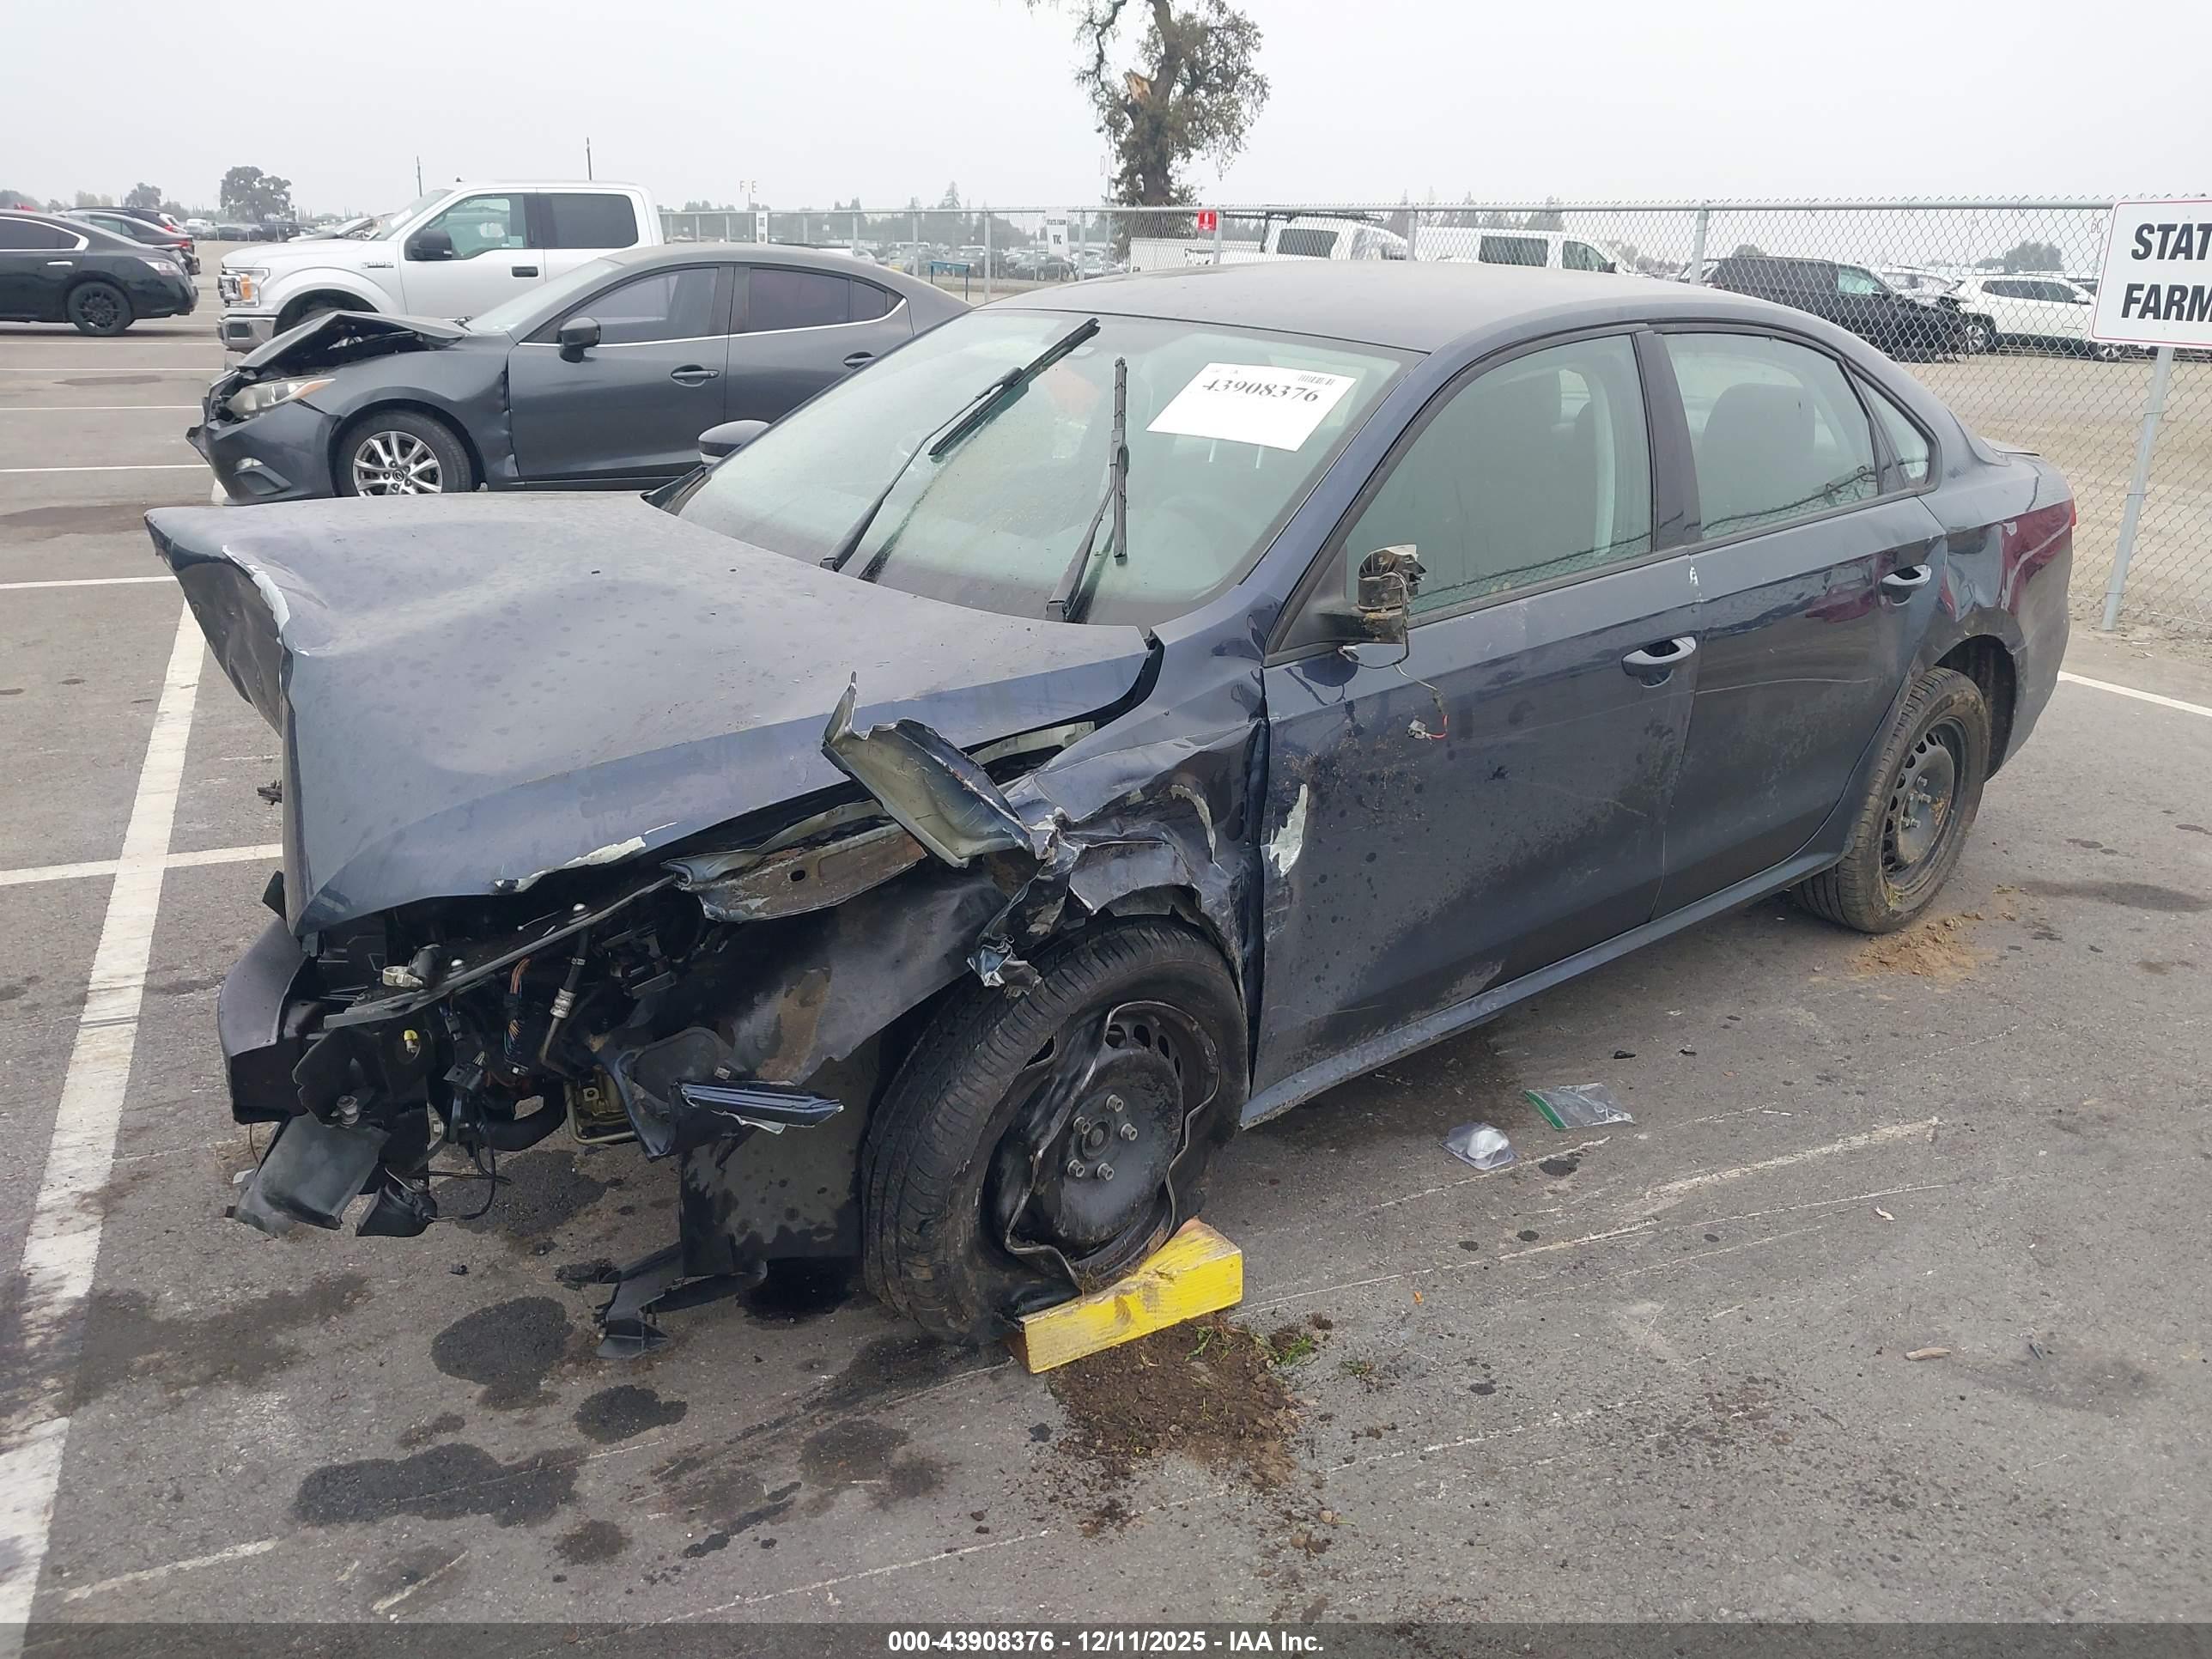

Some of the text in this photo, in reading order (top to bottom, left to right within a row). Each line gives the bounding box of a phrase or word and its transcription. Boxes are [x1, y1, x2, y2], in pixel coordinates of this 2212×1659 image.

[2130, 223, 2212, 260] STAT
[2121, 283, 2212, 322] FARM
[1203, 378, 1320, 403] 43908376
